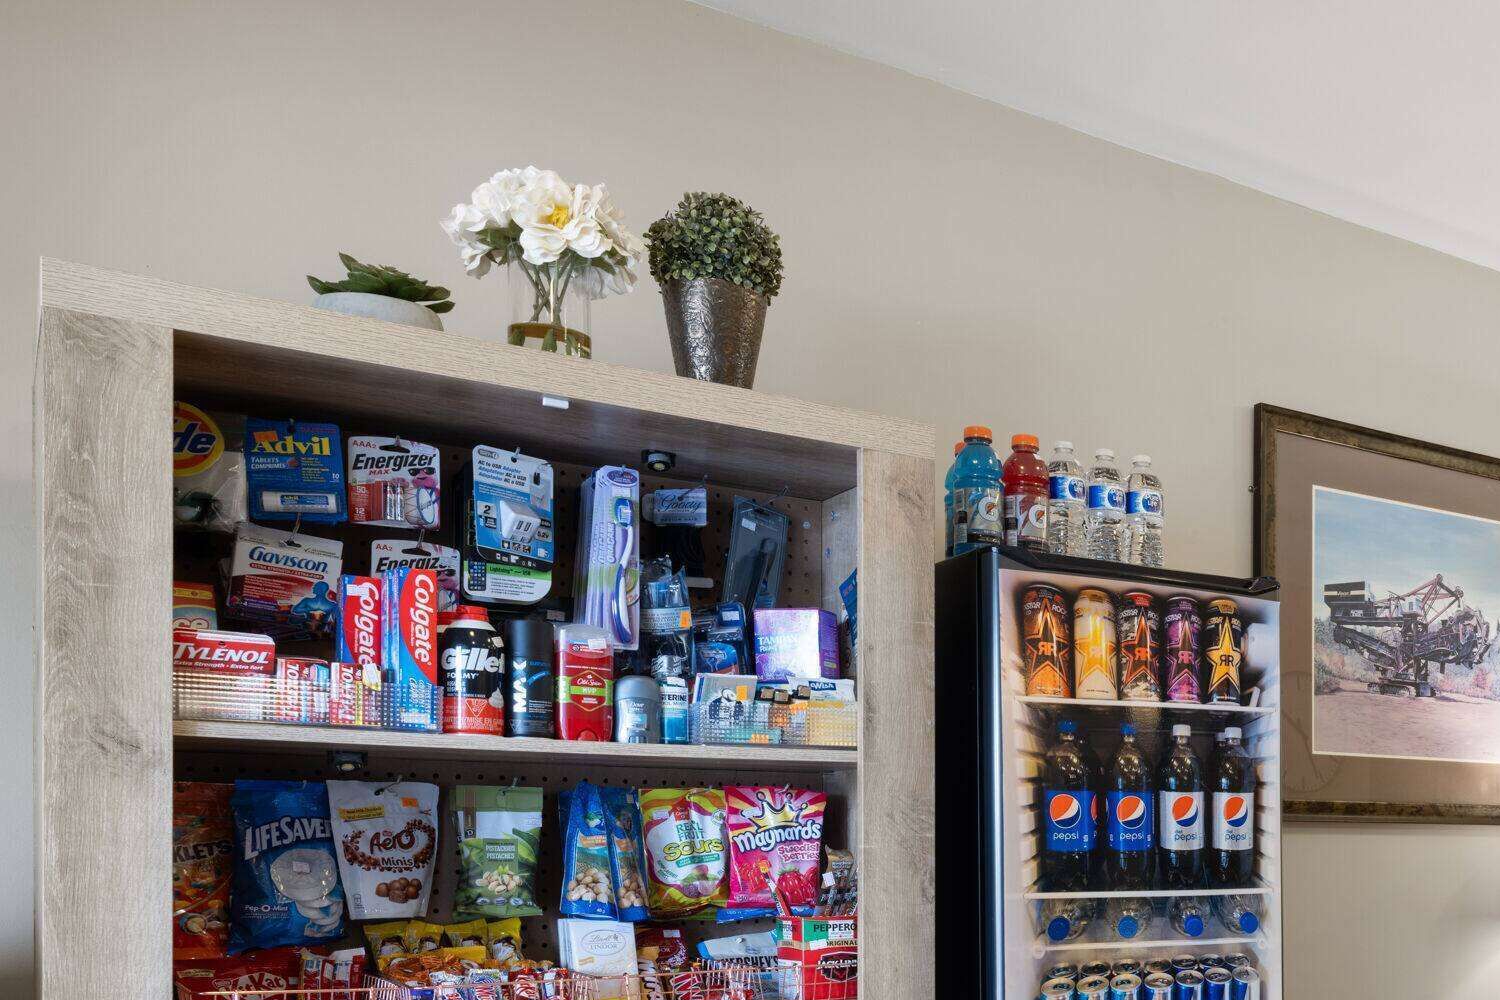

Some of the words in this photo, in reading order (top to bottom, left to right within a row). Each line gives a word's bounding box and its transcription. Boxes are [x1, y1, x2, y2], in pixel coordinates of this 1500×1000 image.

[173, 421, 217, 455] de
[250, 435, 332, 456] Advil
[352, 453, 438, 472] Energizer
[483, 504, 491, 515] 2
[660, 494, 703, 513] Goody
[248, 545, 328, 574] Gaviscon
[375, 556, 457, 572] Energiz
[410, 572, 435, 664] Colgate
[230, 662, 249, 670] Extra
[675, 820, 704, 833] REAL
[677, 830, 704, 842] FRUIT
[733, 821, 823, 854] maynards
[1052, 831, 1080, 842] pepsi
[1119, 831, 1145, 842] pepsi
[1174, 831, 1198, 843] pepsi
[1224, 832, 1247, 843] pepsi
[777, 842, 821, 855] Swedish
[380, 856, 416, 869] Minis
[781, 851, 820, 864] Berries
[826, 939, 858, 948] RIGINAL
[719, 955, 779, 970] HERSHEY'S
